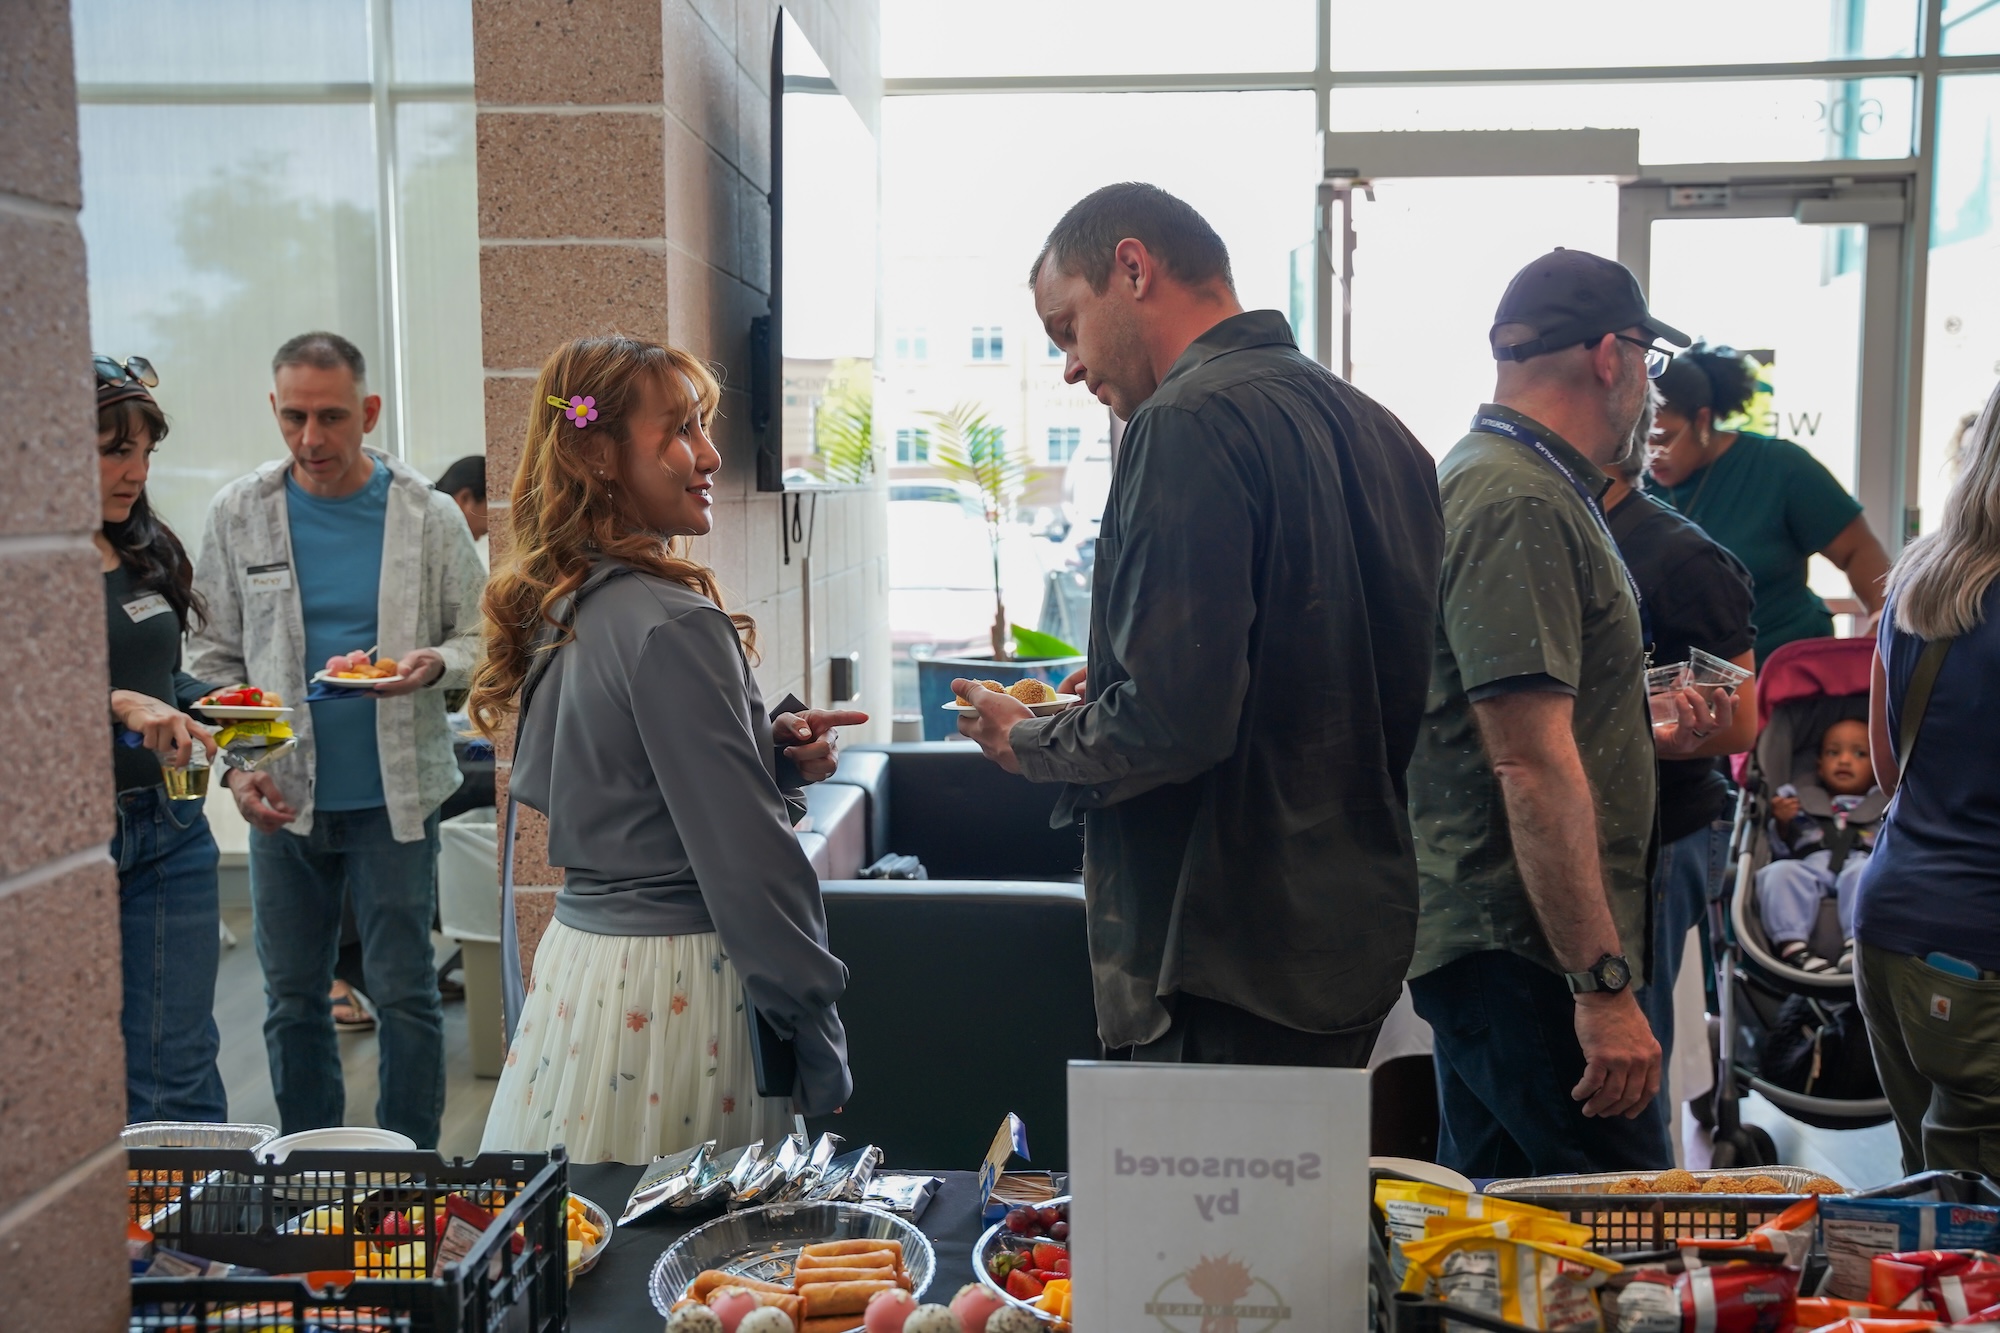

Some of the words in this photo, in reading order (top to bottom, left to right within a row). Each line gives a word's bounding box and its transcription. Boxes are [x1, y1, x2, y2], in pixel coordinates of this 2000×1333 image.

[1535, 441, 1572, 479] TECHTALKS
[1388, 1203, 1421, 1212] Nutrition
[1423, 1206, 1445, 1216] Facts
